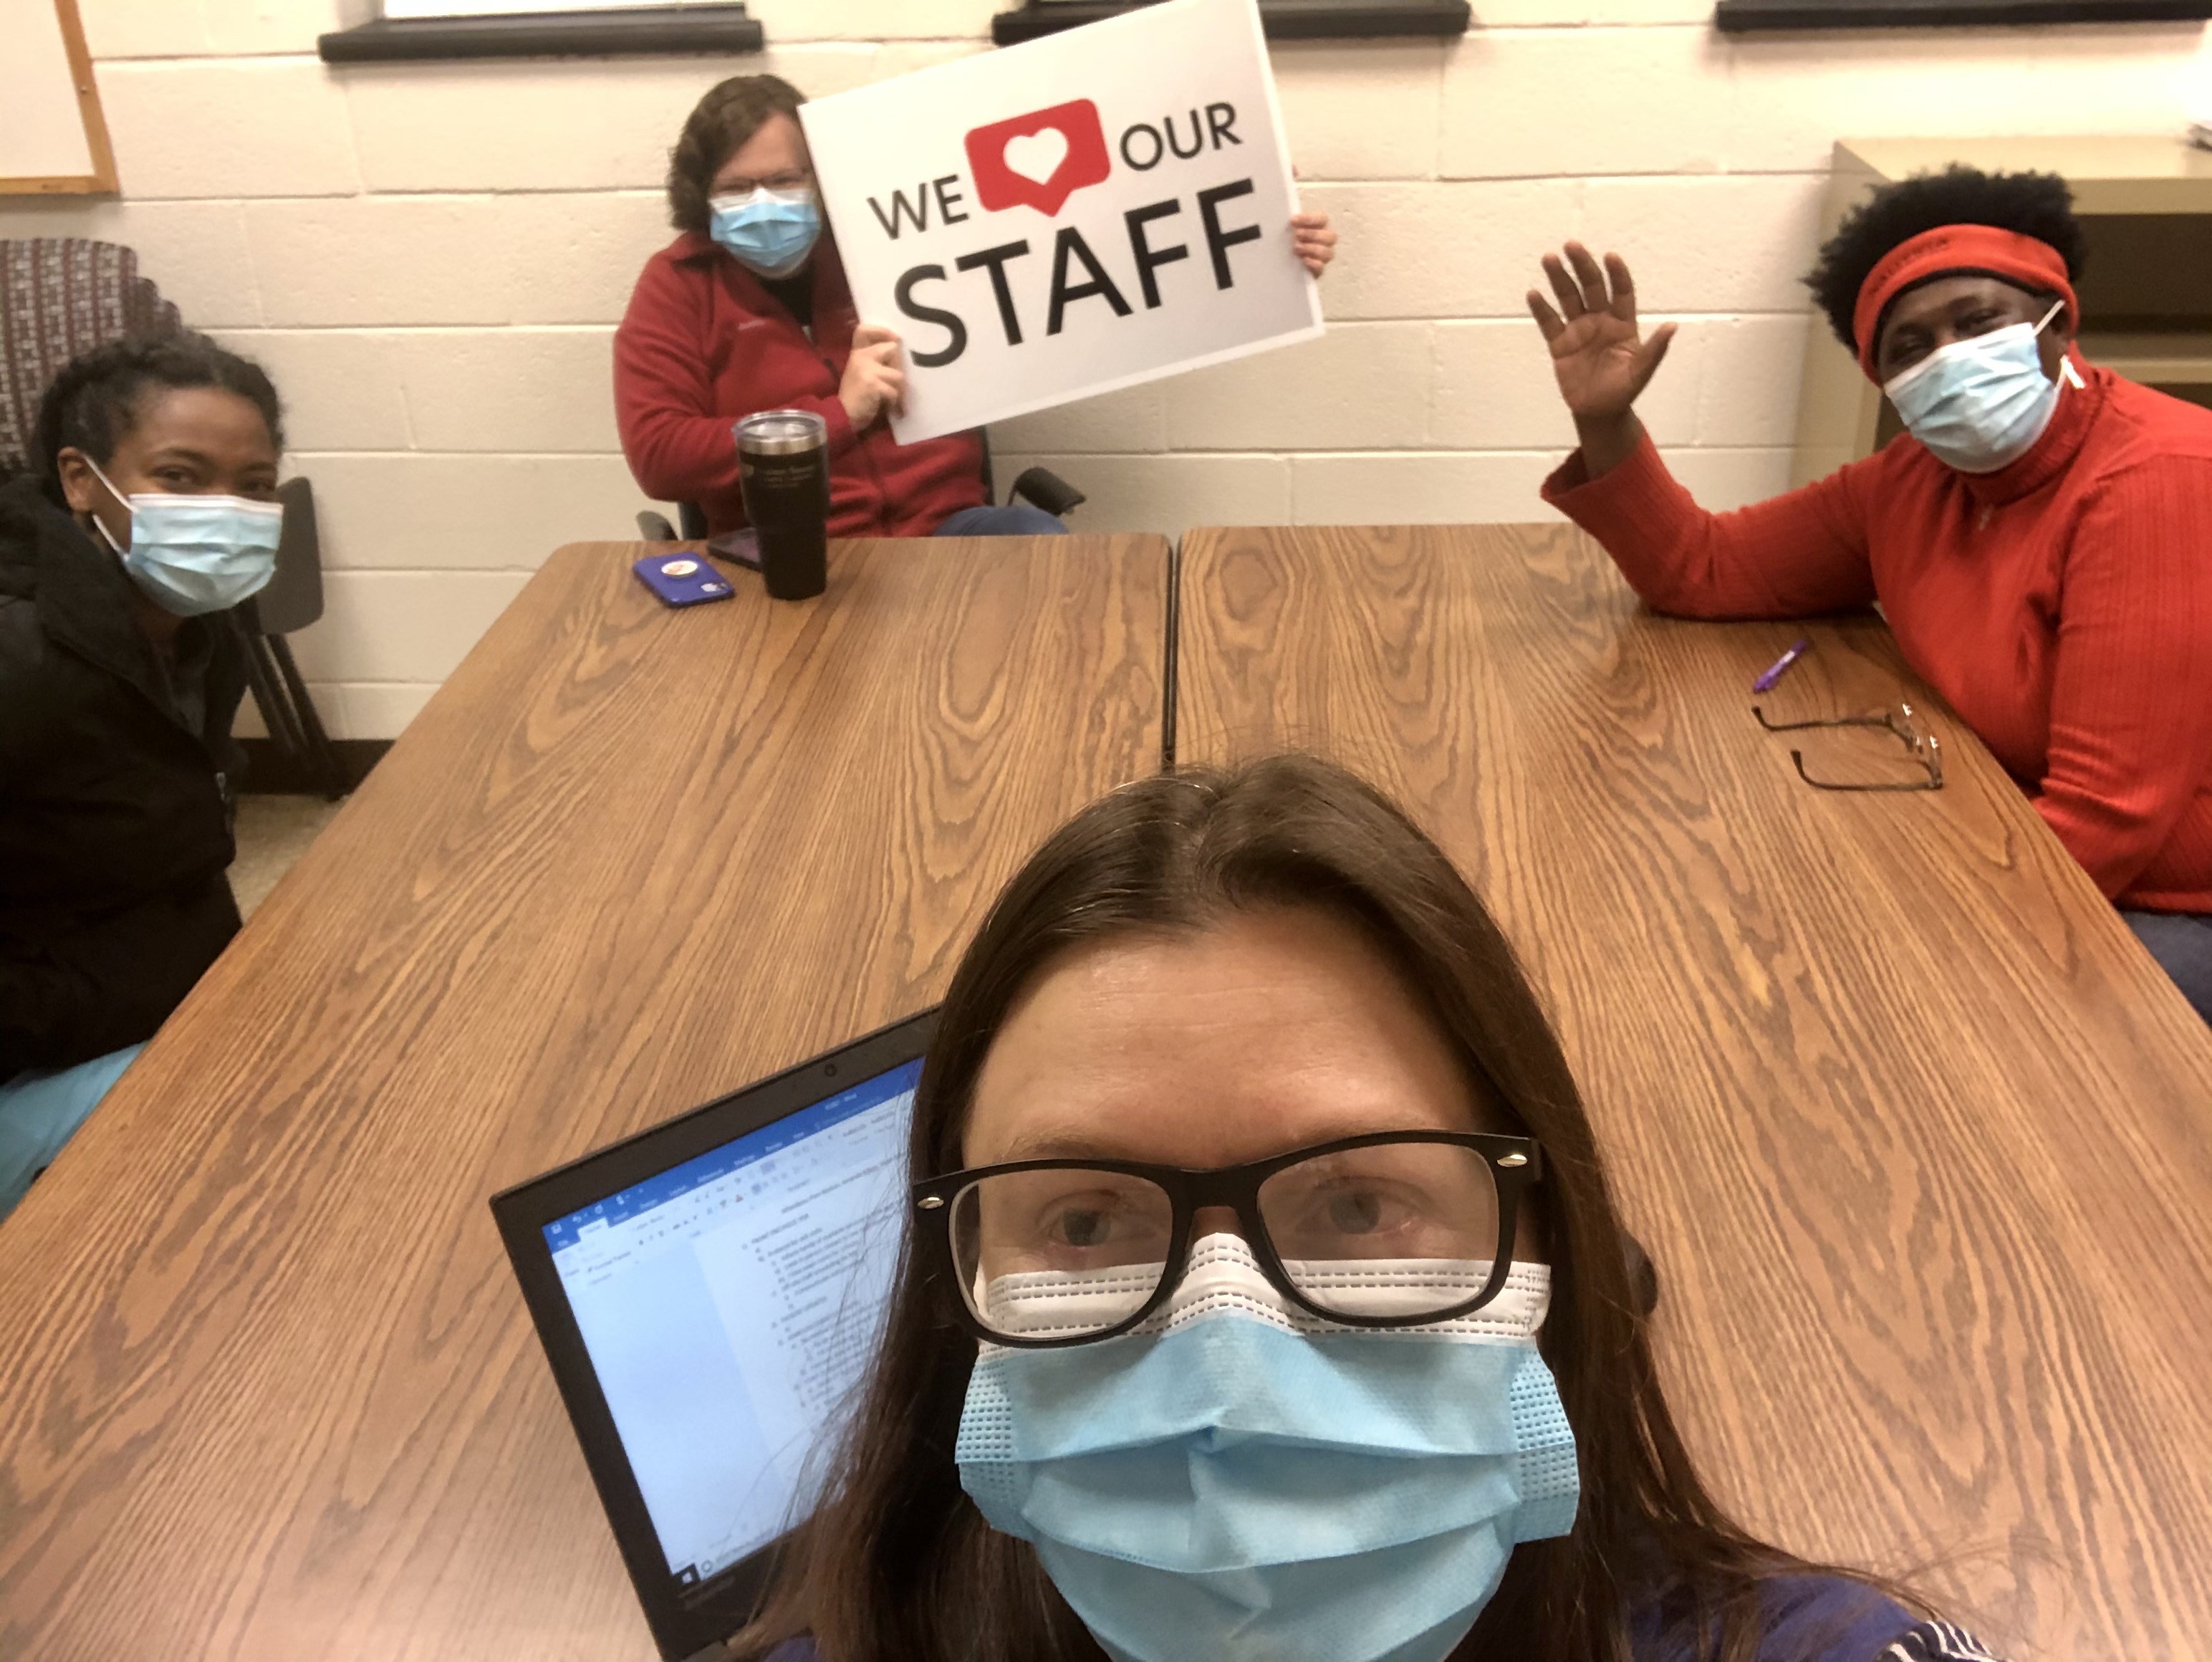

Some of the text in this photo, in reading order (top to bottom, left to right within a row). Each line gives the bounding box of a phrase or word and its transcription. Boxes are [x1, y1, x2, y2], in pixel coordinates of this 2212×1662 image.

[867, 102, 1242, 240] WE OUR
[894, 178, 1261, 368] STAFF
